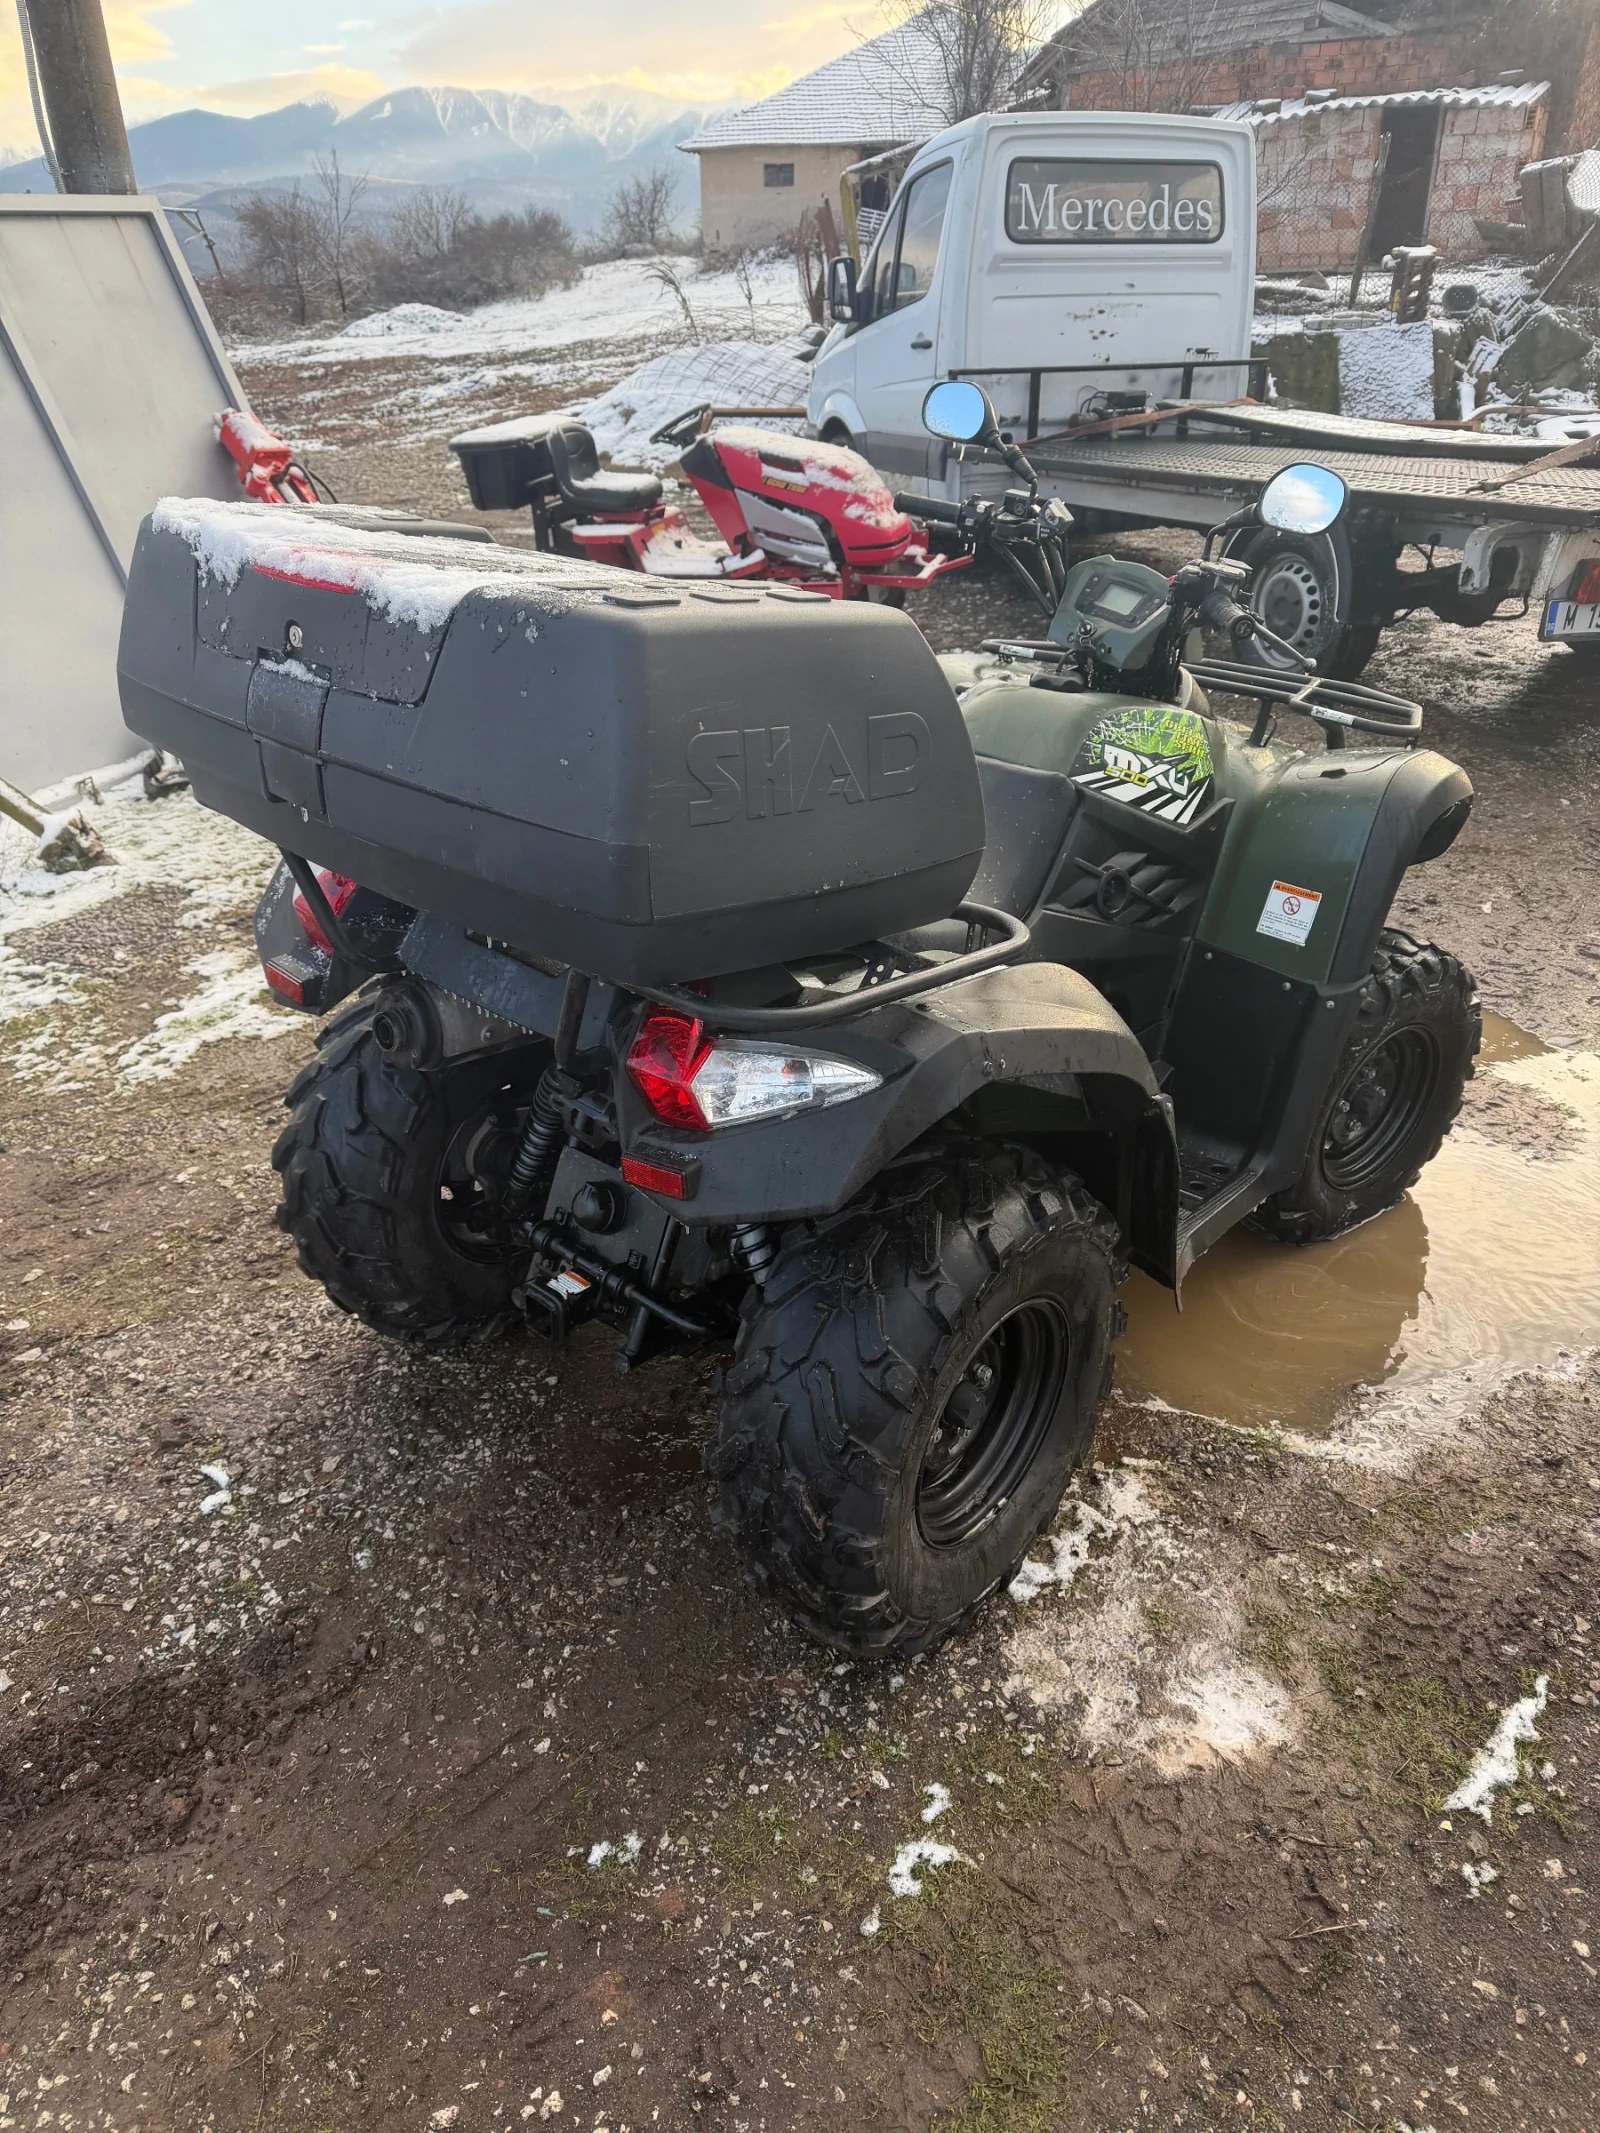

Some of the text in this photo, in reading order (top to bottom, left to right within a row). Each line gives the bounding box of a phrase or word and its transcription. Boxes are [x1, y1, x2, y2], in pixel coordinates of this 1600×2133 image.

[1017, 182, 1213, 232] Mercedes
[1563, 604, 1578, 630] M
[685, 711, 932, 828] SHAD
[1103, 743, 1196, 797] MXU
[1104, 766, 1149, 788] 500
